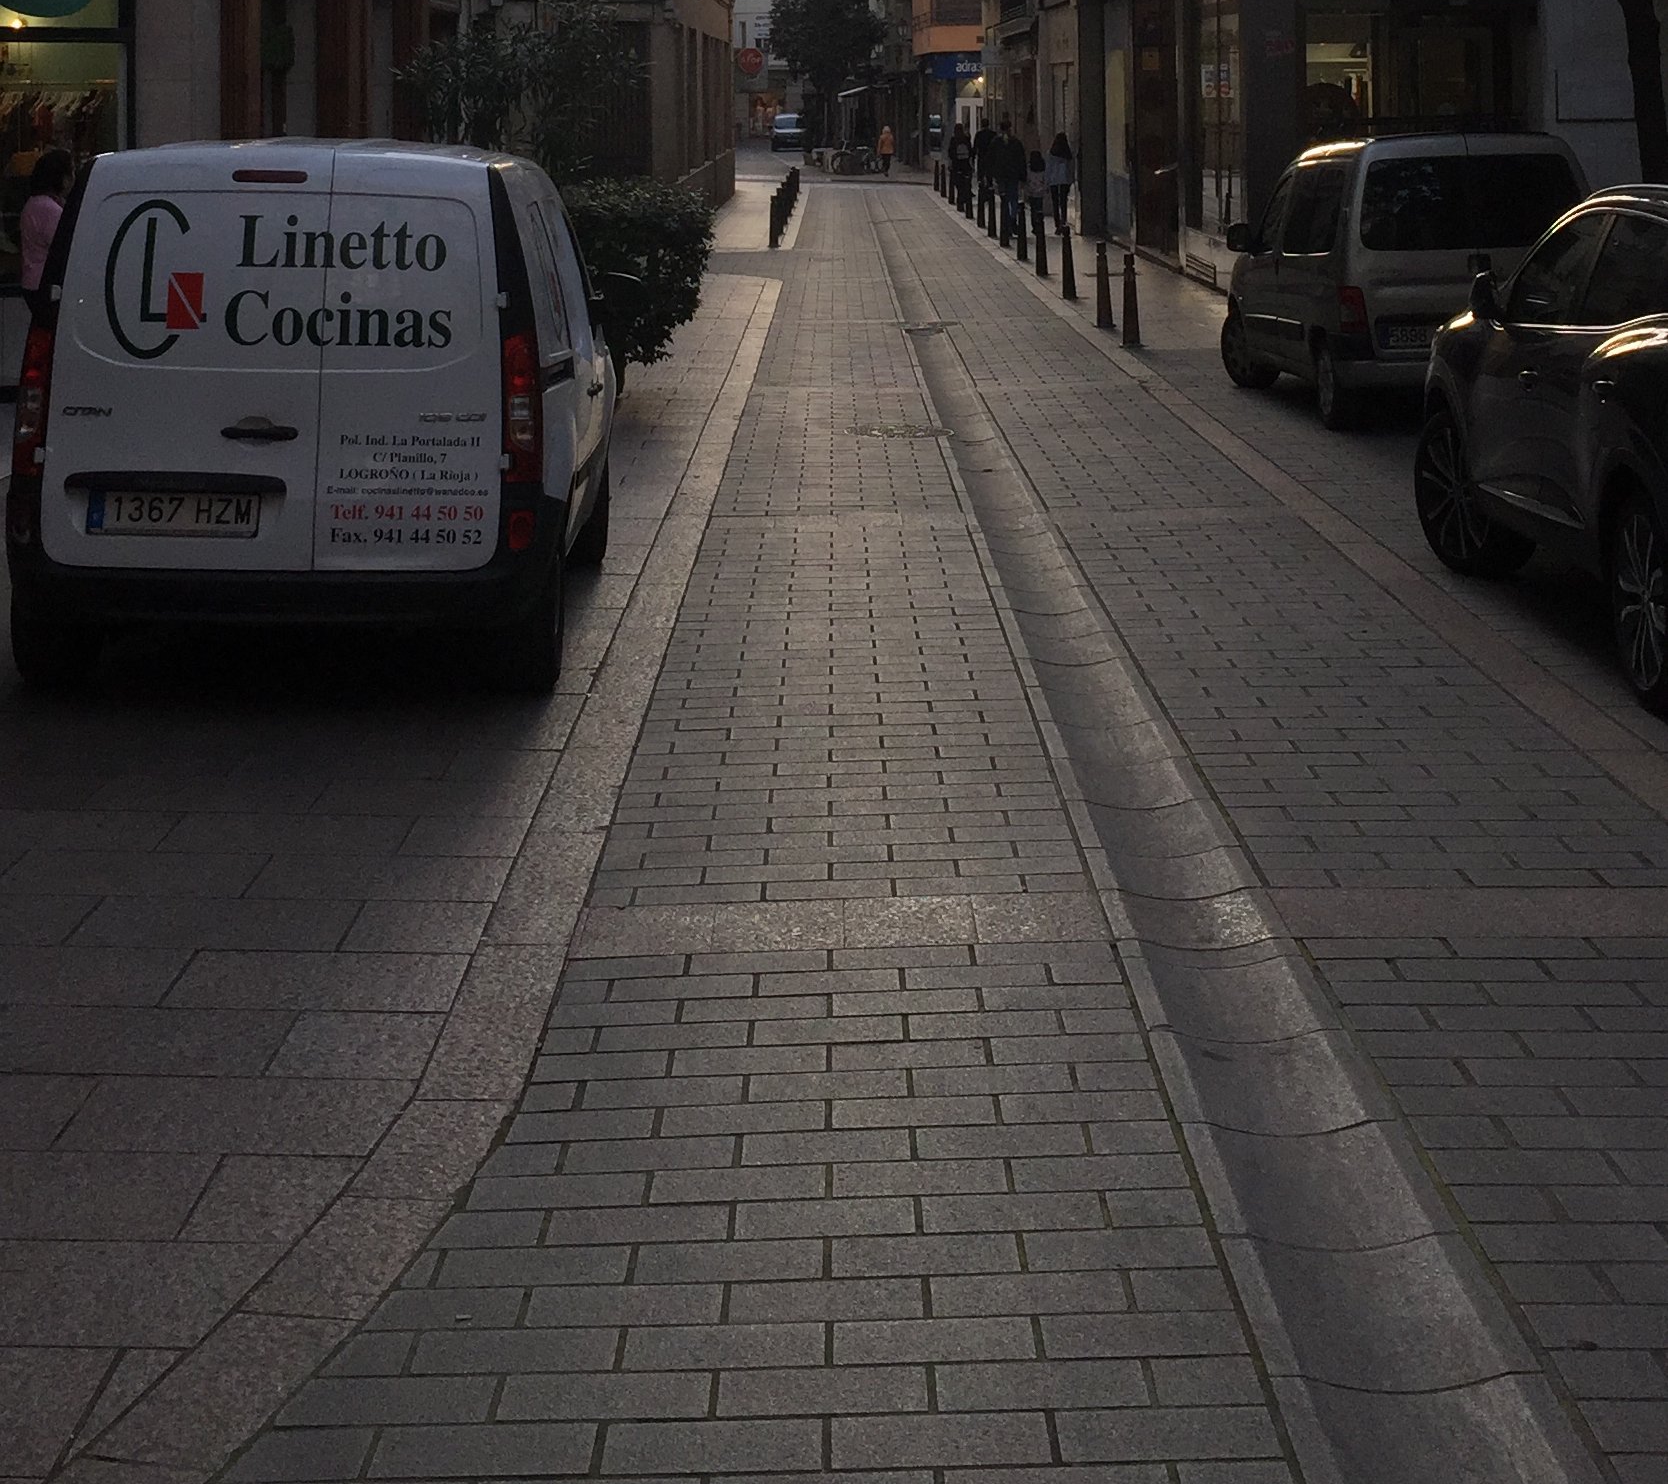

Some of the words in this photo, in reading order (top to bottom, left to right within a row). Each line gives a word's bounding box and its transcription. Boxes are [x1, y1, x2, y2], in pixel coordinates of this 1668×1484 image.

[236, 214, 447, 272] Linetto
[224, 289, 453, 349] Cocinas
[339, 434, 363, 447] Pol.
[365, 435, 389, 447] Ind.
[392, 435, 408, 447] La
[410, 436, 468, 448] Portalada
[440, 453, 448, 464] 7
[339, 467, 411, 481] LOGROÑO
[113, 496, 185, 524] 1367
[195, 498, 253, 525] HZM
[330, 503, 369, 521] Telf.
[374, 504, 404, 521] 941
[410, 504, 433, 521] 44
[436, 505, 458, 522] 50
[463, 506, 484, 522] 50
[330, 526, 369, 544] Fax.
[373, 528, 403, 544] 941
[409, 528, 432, 544] 44
[435, 529, 457, 545] 50
[462, 529, 484, 545] 52
